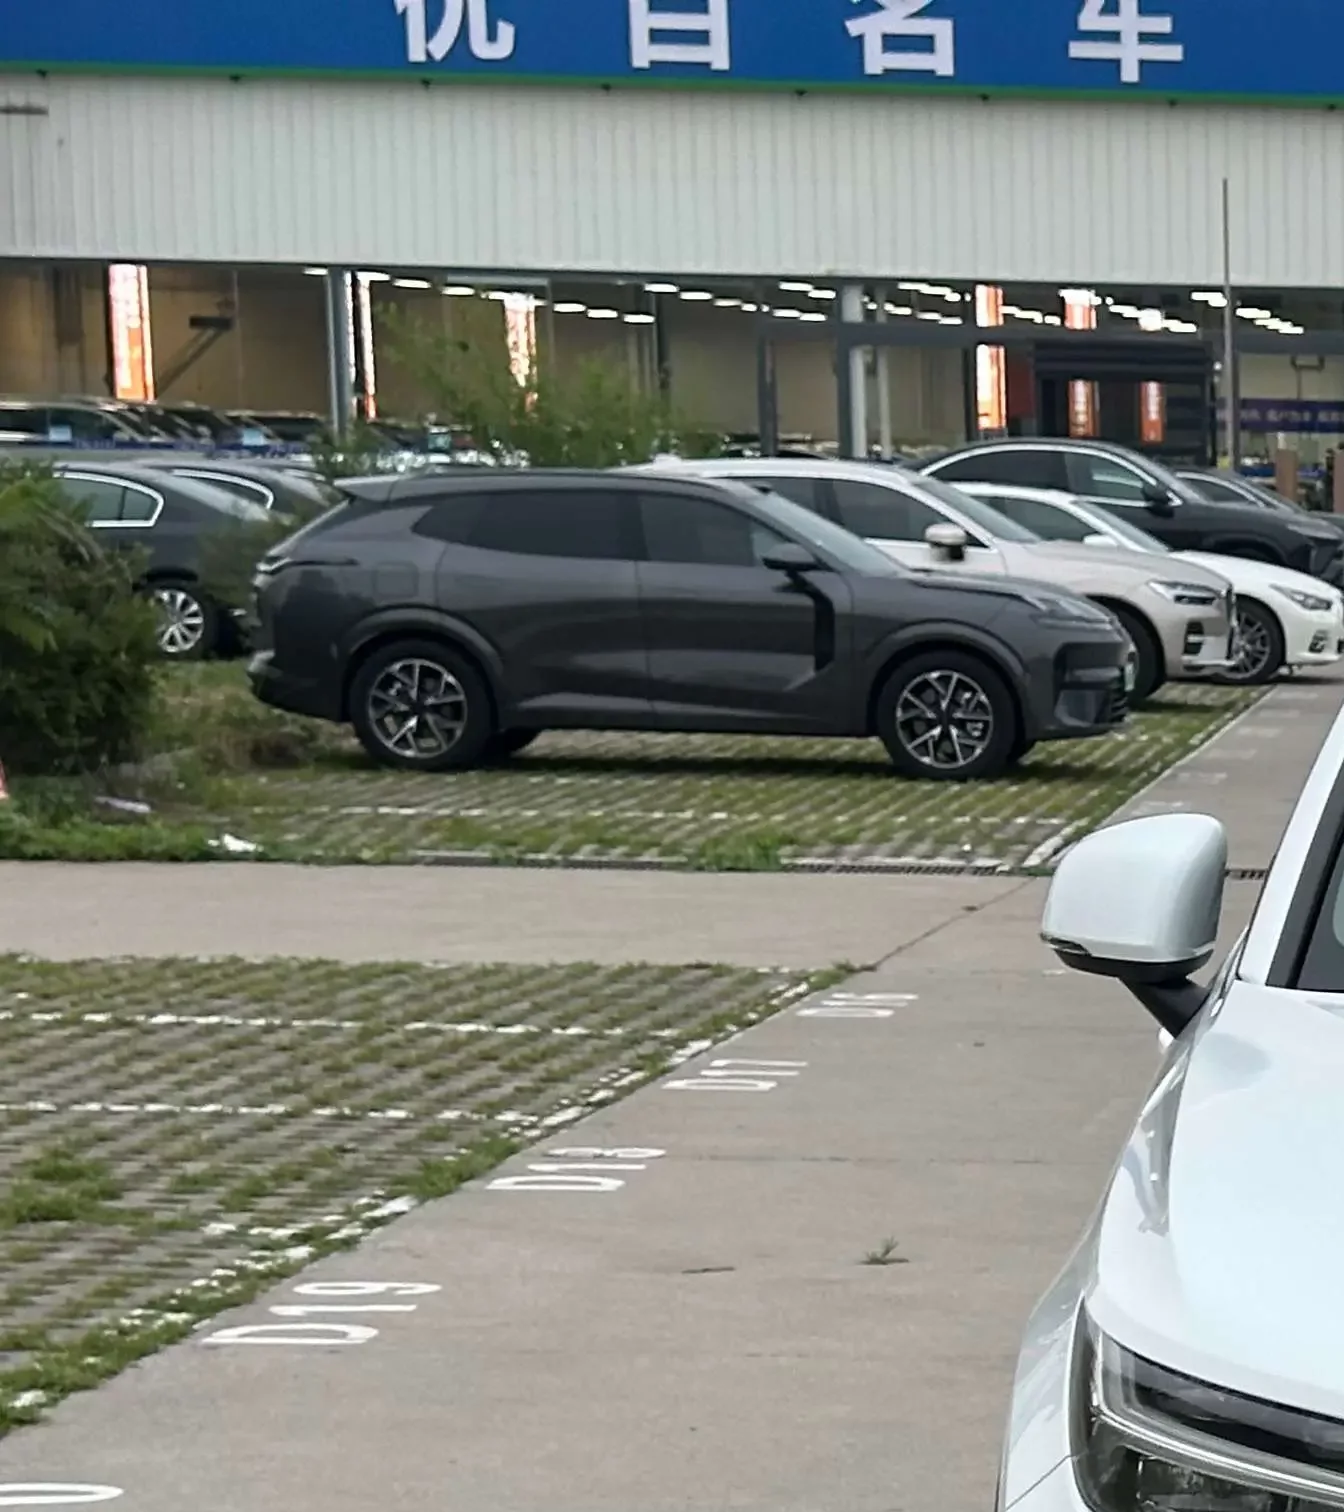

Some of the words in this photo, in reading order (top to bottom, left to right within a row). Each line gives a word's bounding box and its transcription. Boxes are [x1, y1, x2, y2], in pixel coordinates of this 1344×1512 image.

[661, 1058, 809, 1092] D17
[484, 1146, 667, 1192] D18
[202, 1281, 443, 1345] D19
